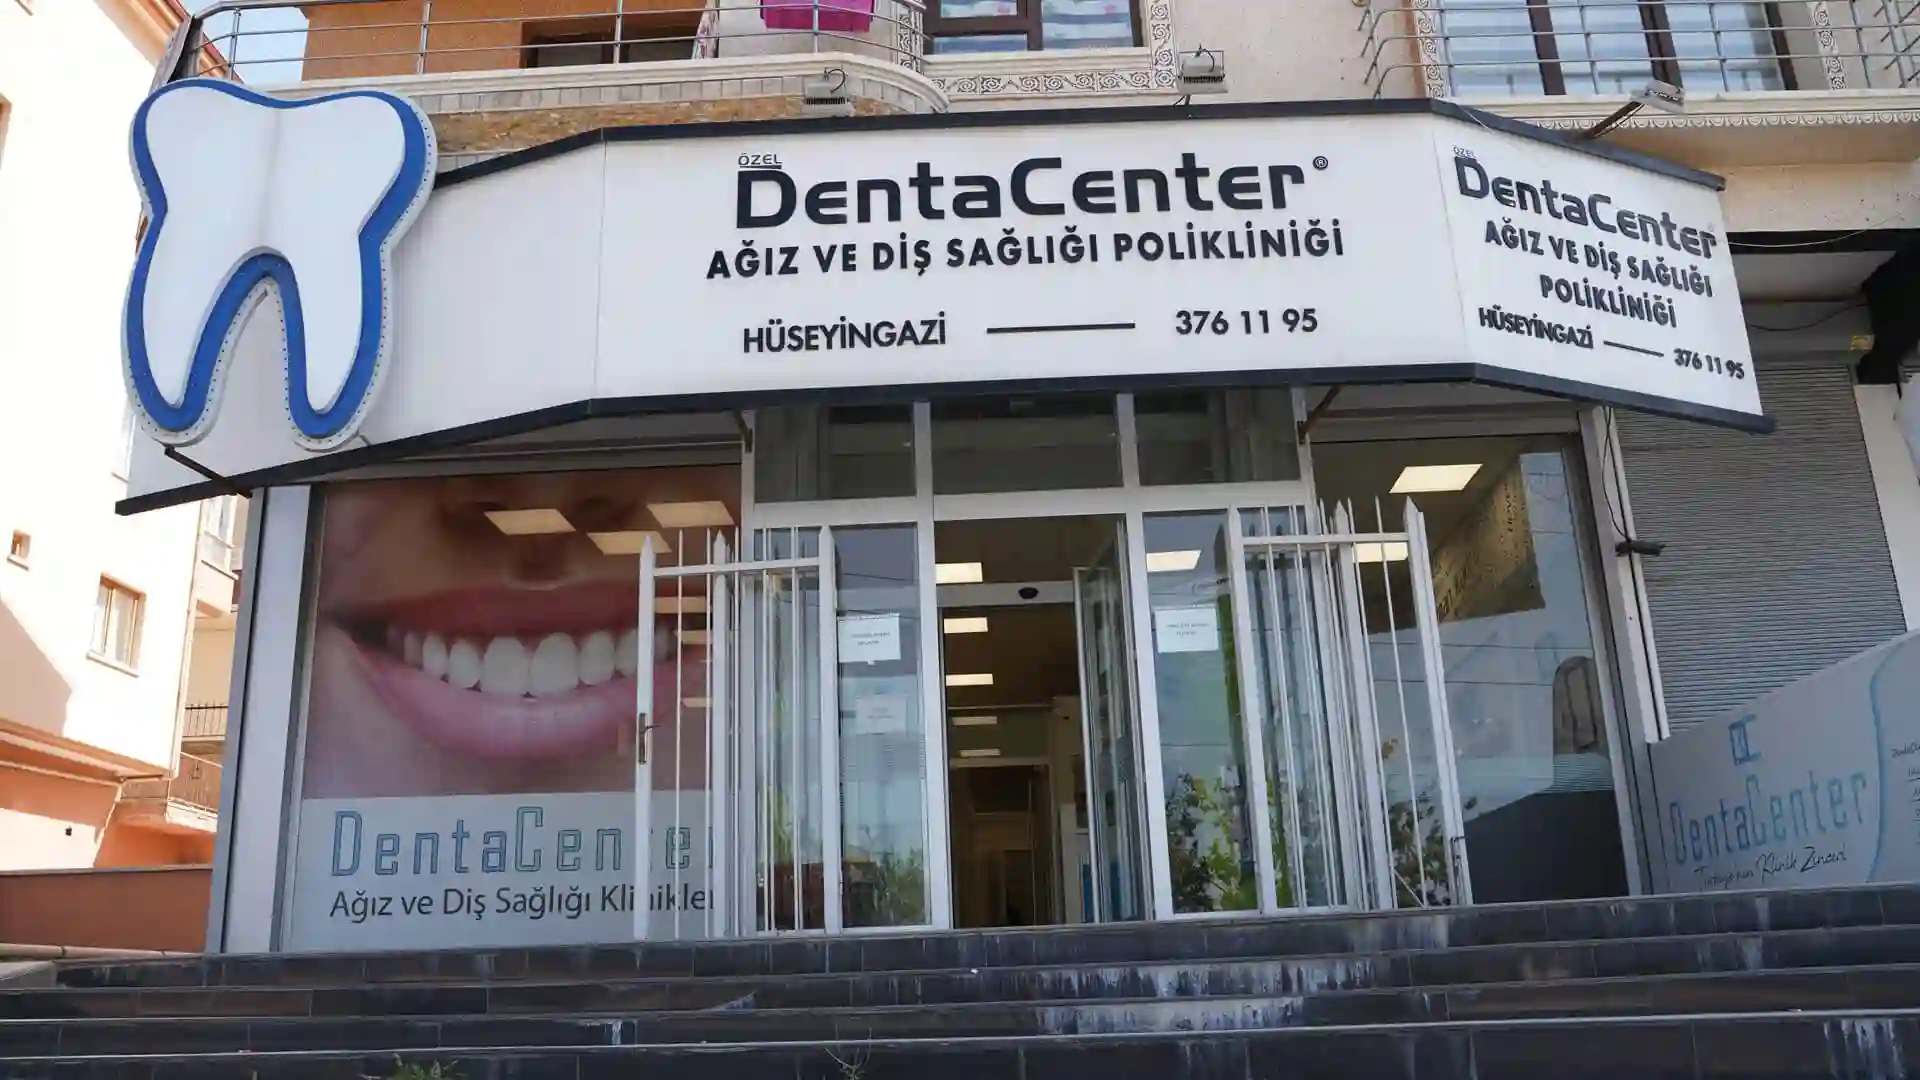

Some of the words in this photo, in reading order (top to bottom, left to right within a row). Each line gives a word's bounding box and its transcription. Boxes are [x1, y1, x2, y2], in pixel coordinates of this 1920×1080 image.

[738, 152, 783, 166] ÖZEL
[1454, 155, 1717, 260] DentaCenter
[707, 240, 800, 279] AĞIZ
[813, 243, 857, 274] VE
[873, 231, 932, 277] DİŞ
[947, 224, 1098, 268] SAĞLIĞI
[1114, 218, 1344, 262] POLİKLİNİĞİ
[1485, 216, 1545, 256] AĞIZ
[1547, 235, 1580, 265] VE
[1583, 240, 1622, 280] DİŞ
[1626, 255, 1713, 298] SAĞLIĞI
[743, 310, 946, 354] HÜSEYİNGAZİ
[1175, 310, 1229, 336] 376
[1240, 309, 1270, 335] 11
[1282, 307, 1318, 333] 95
[1539, 274, 1678, 329] POLİKLİNİĞİ
[1478, 304, 1594, 350] HÜSEYİNGAZİ
[1673, 348, 1703, 370] 376
[1705, 354, 1722, 375] 11
[1725, 359, 1745, 380] 95
[331, 806, 714, 876] DentaCene
[1669, 770, 1867, 865] DentaCenter
[329, 885, 393, 923] Ağız
[400, 894, 433, 917] ve
[442, 887, 486, 920] Diş
[495, 885, 592, 920] Sağlığı
[600, 883, 714, 911] Kliikle
